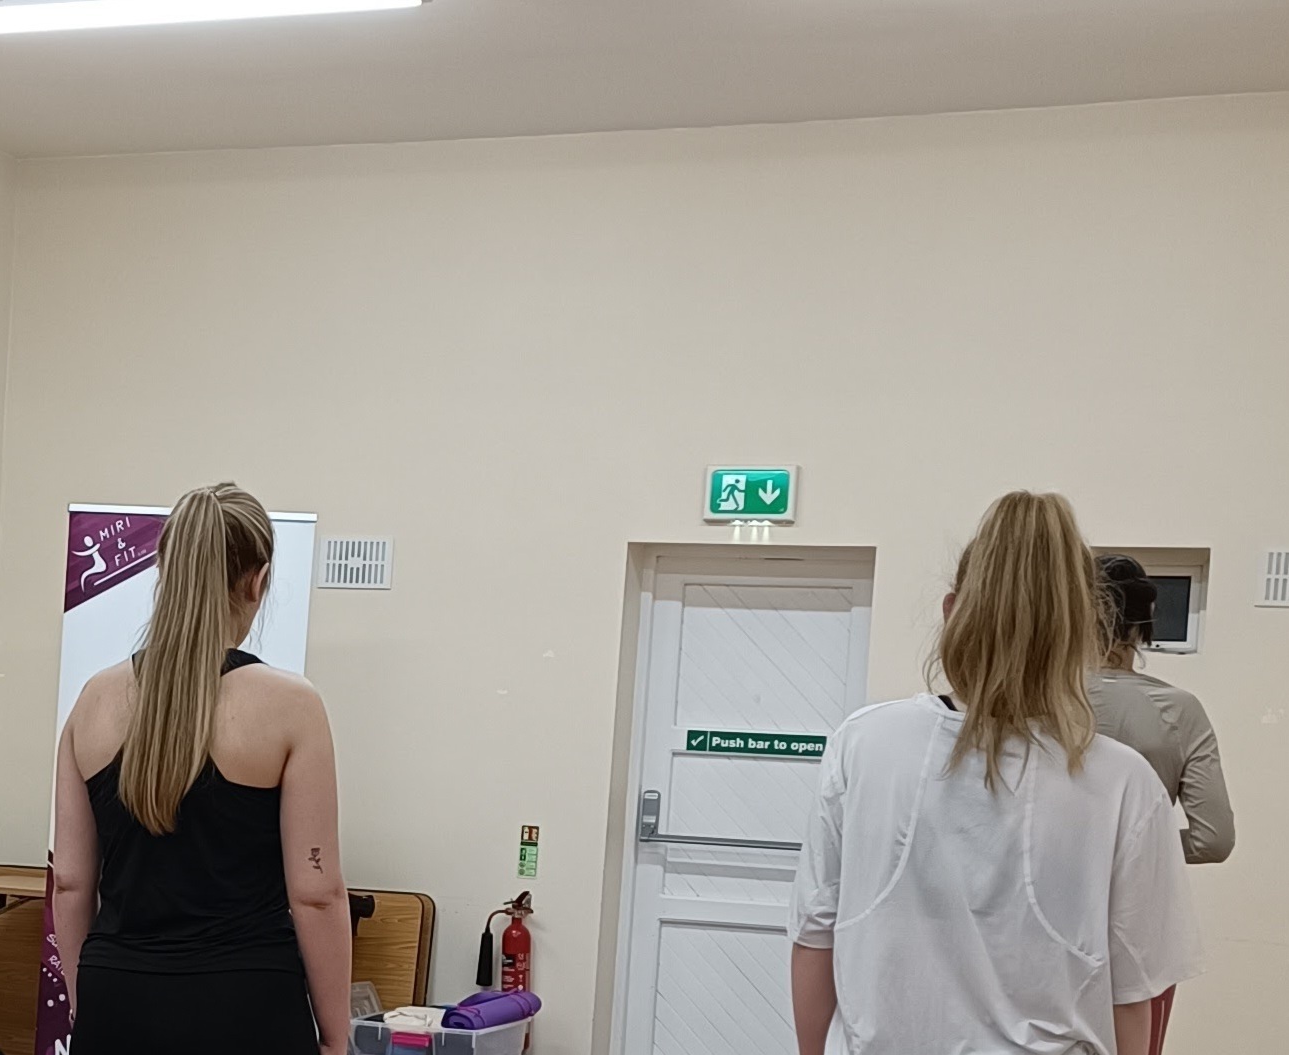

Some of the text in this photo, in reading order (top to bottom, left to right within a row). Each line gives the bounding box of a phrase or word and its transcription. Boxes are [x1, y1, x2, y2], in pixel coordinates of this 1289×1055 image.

[99, 516, 130, 541] MIRI
[117, 538, 126, 549] &
[114, 546, 136, 567] FIT
[711, 736, 823, 753] Push bar to open
